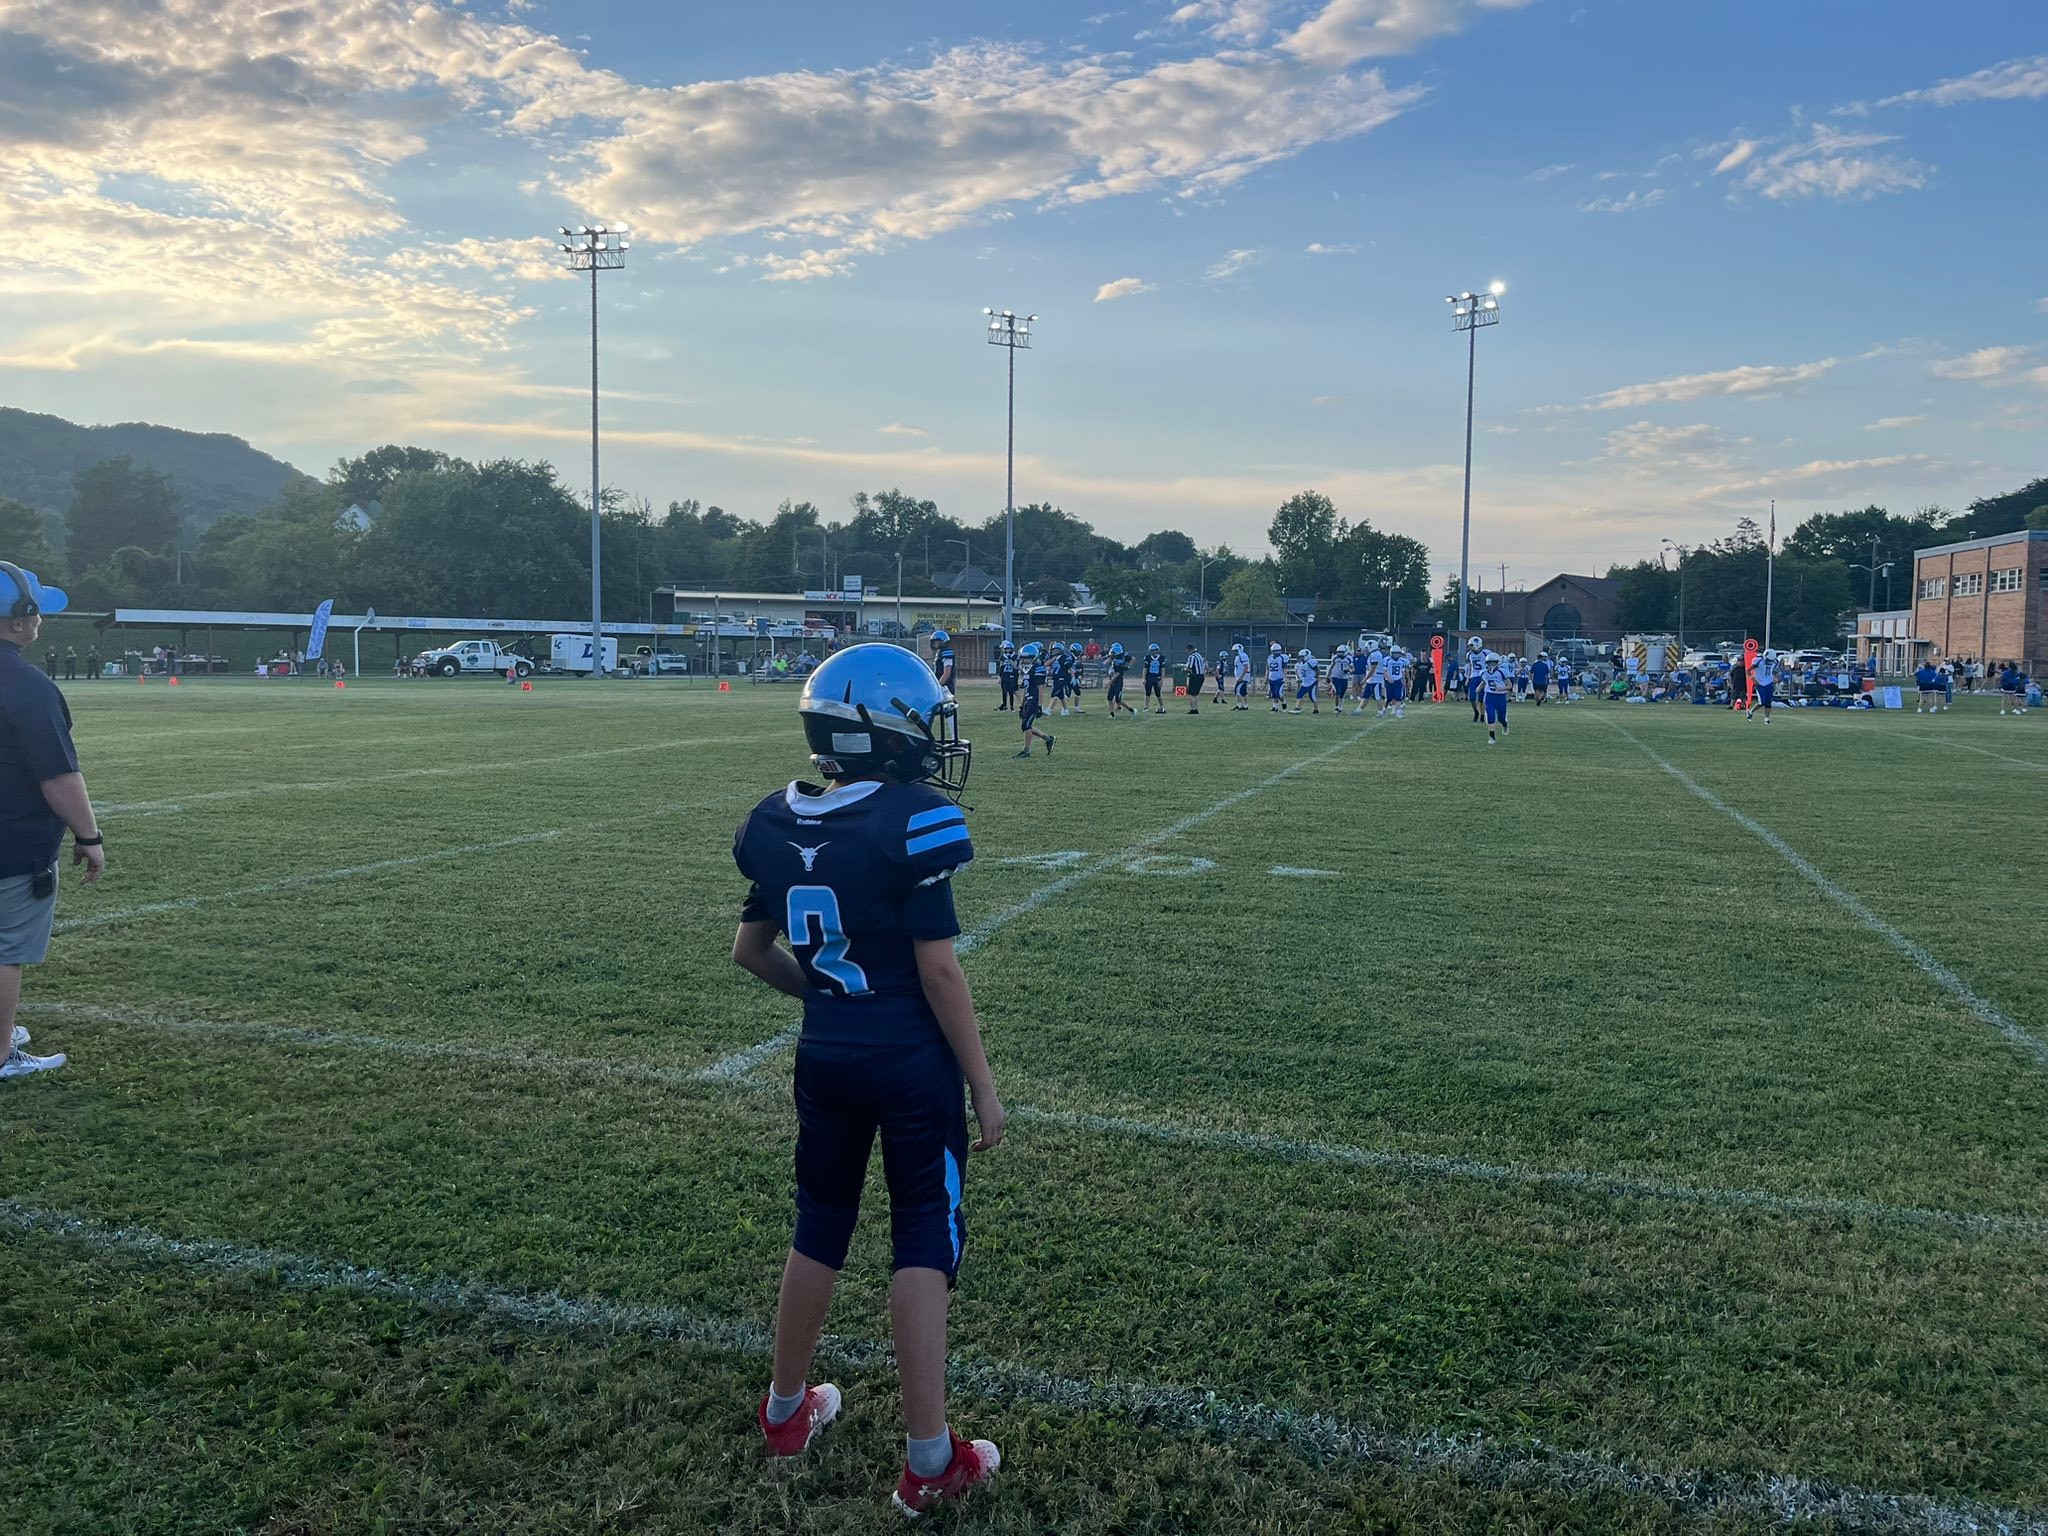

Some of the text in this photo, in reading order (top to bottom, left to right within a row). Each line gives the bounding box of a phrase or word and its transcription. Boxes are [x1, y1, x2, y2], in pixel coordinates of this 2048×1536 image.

[1269, 663, 1279, 672] 52
[1391, 665, 1401, 676] 18
[1176, 687, 1185, 696] 50
[786, 885, 876, 997] 2
